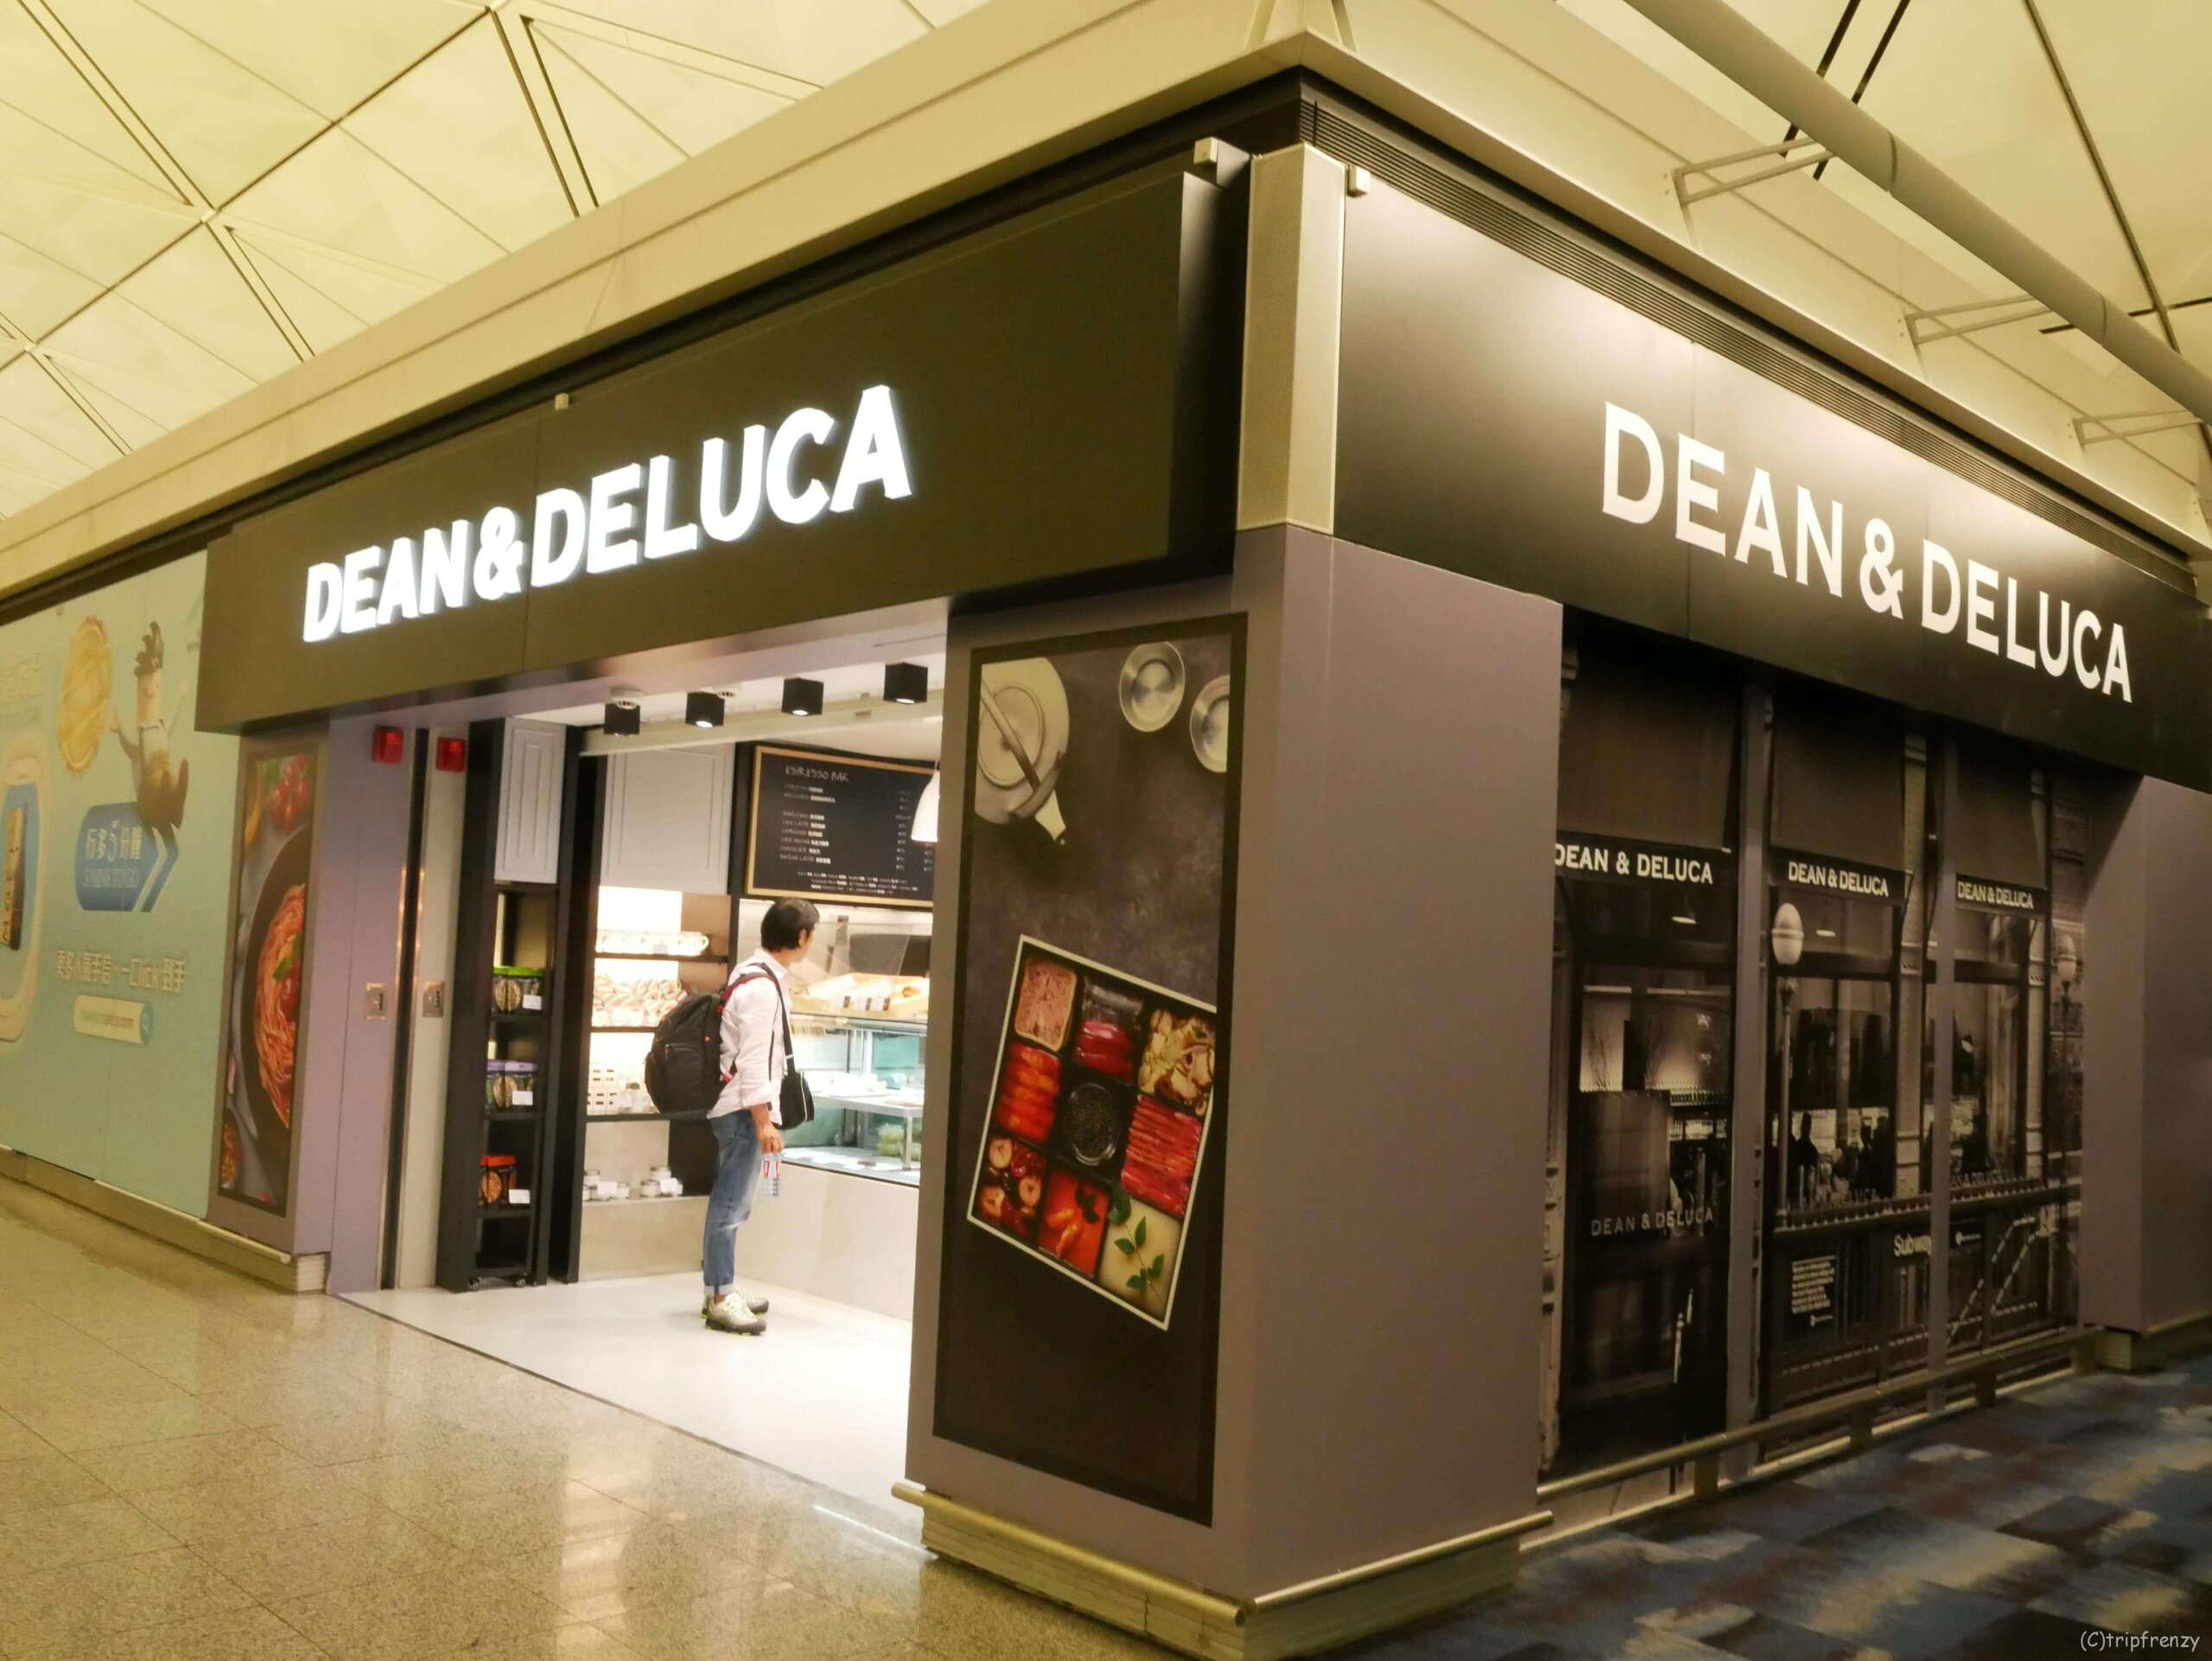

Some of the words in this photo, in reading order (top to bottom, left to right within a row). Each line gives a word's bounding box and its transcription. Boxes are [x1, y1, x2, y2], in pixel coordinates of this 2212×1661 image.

[304, 519, 468, 642] DEAN
[473, 506, 524, 601] &
[531, 385, 912, 589] DELUCA
[1603, 401, 1843, 598] DEAN
[1859, 519, 1904, 619] &
[1921, 539, 2133, 703] DELUCA
[785, 766, 829, 780] ESPRESSO
[831, 771, 849, 782] BAR
[1554, 843, 1609, 872] DEAN
[1616, 851, 1630, 875] &
[1637, 853, 1713, 884] DELUCA
[1788, 861, 1826, 888] DEAN
[1827, 871, 1838, 888] &
[1840, 870, 1889, 897] DELUCA
[1957, 881, 1986, 902] DEAN
[1987, 888, 1995, 903] &
[1995, 888, 2034, 909] DELUCA
[1591, 1216, 1636, 1237] DEAN
[1642, 1212, 1650, 1230] &
[1656, 1207, 1713, 1229] DELUCA
